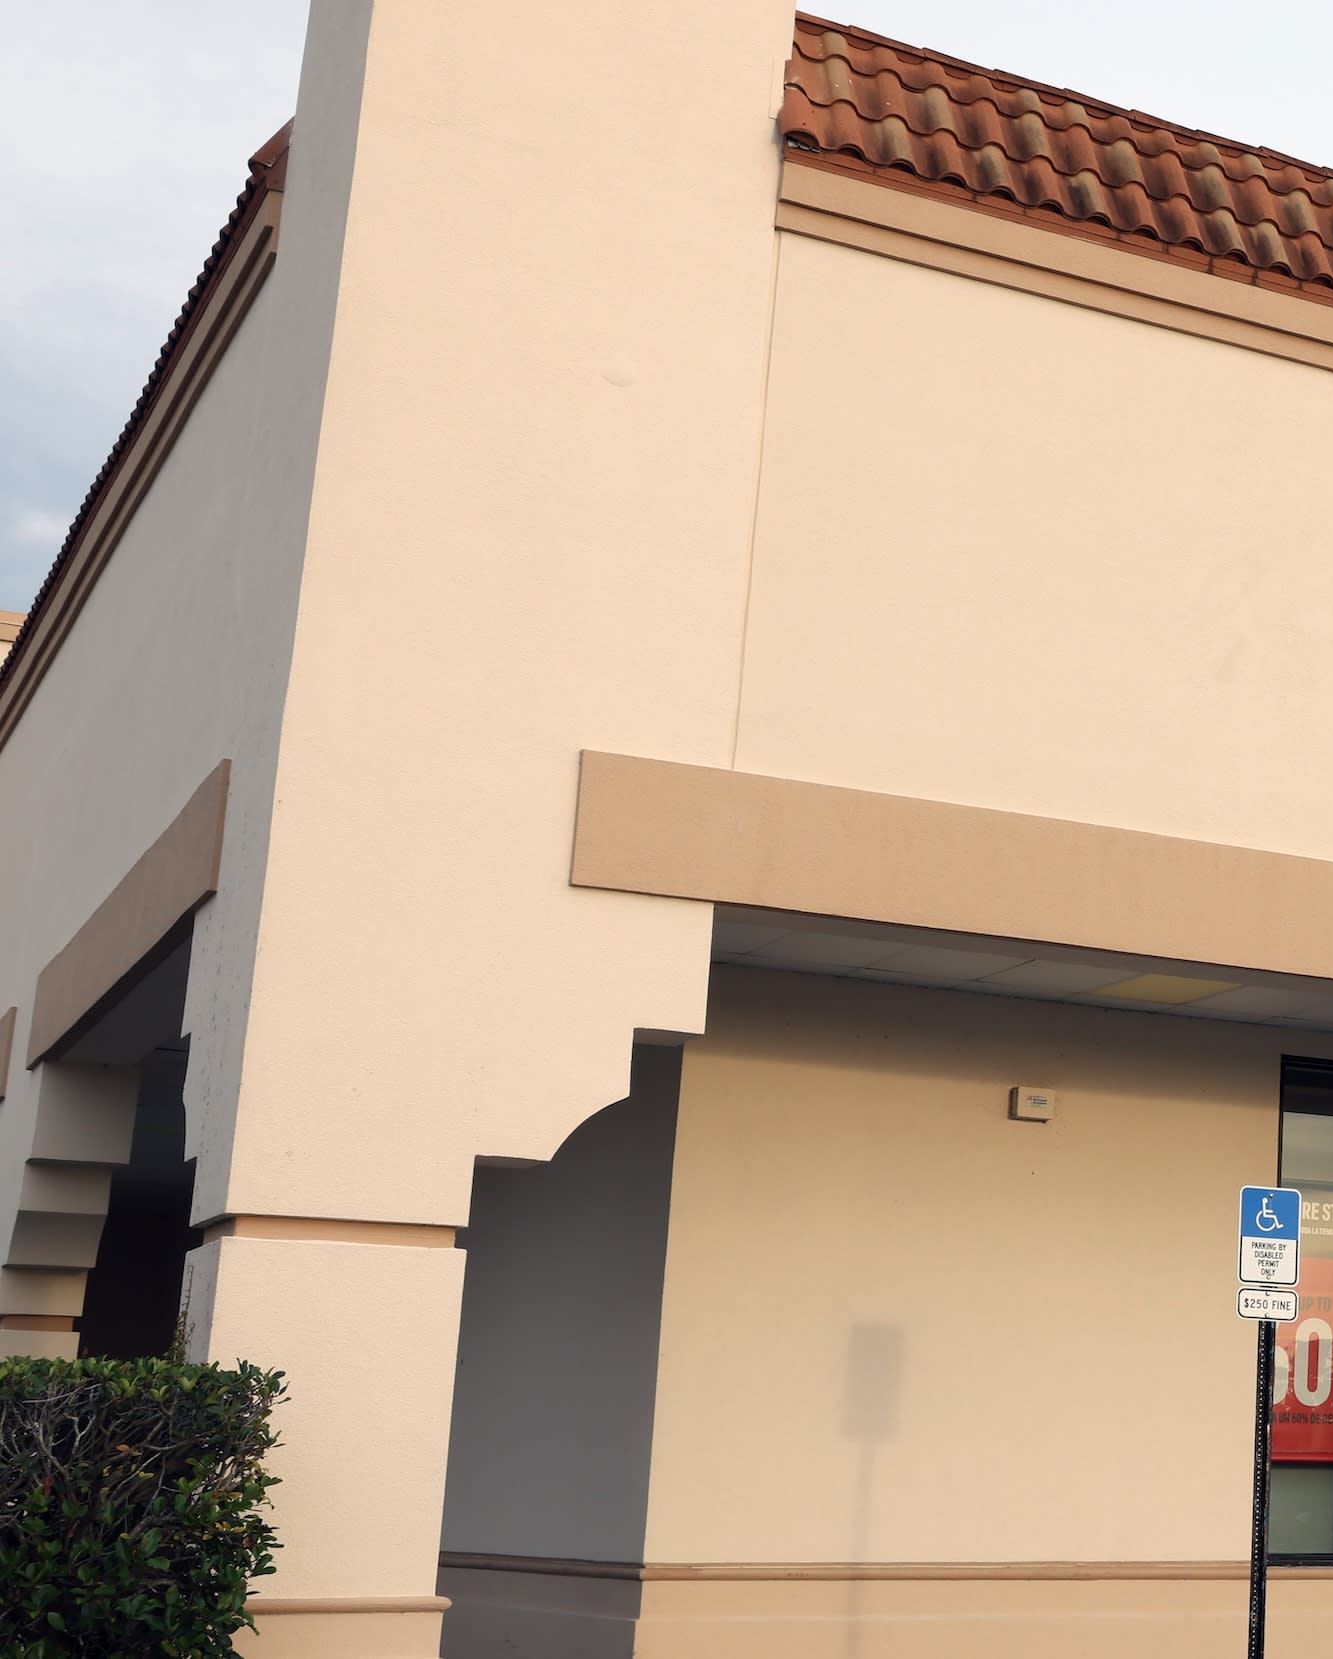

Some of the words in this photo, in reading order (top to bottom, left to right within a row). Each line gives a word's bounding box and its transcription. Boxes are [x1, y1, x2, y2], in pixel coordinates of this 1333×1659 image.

[1251, 1241, 1277, 1251] PARKING
[1279, 1243, 1287, 1251] BY
[1254, 1250, 1284, 1260] DISABLED
[1257, 1259, 1279, 1268] PERMIT
[1260, 1268, 1276, 1277] ONLY
[1243, 1298, 1269, 1310] $250
[1271, 1300, 1292, 1311] FINE
[1317, 1296, 1332, 1313] TO
